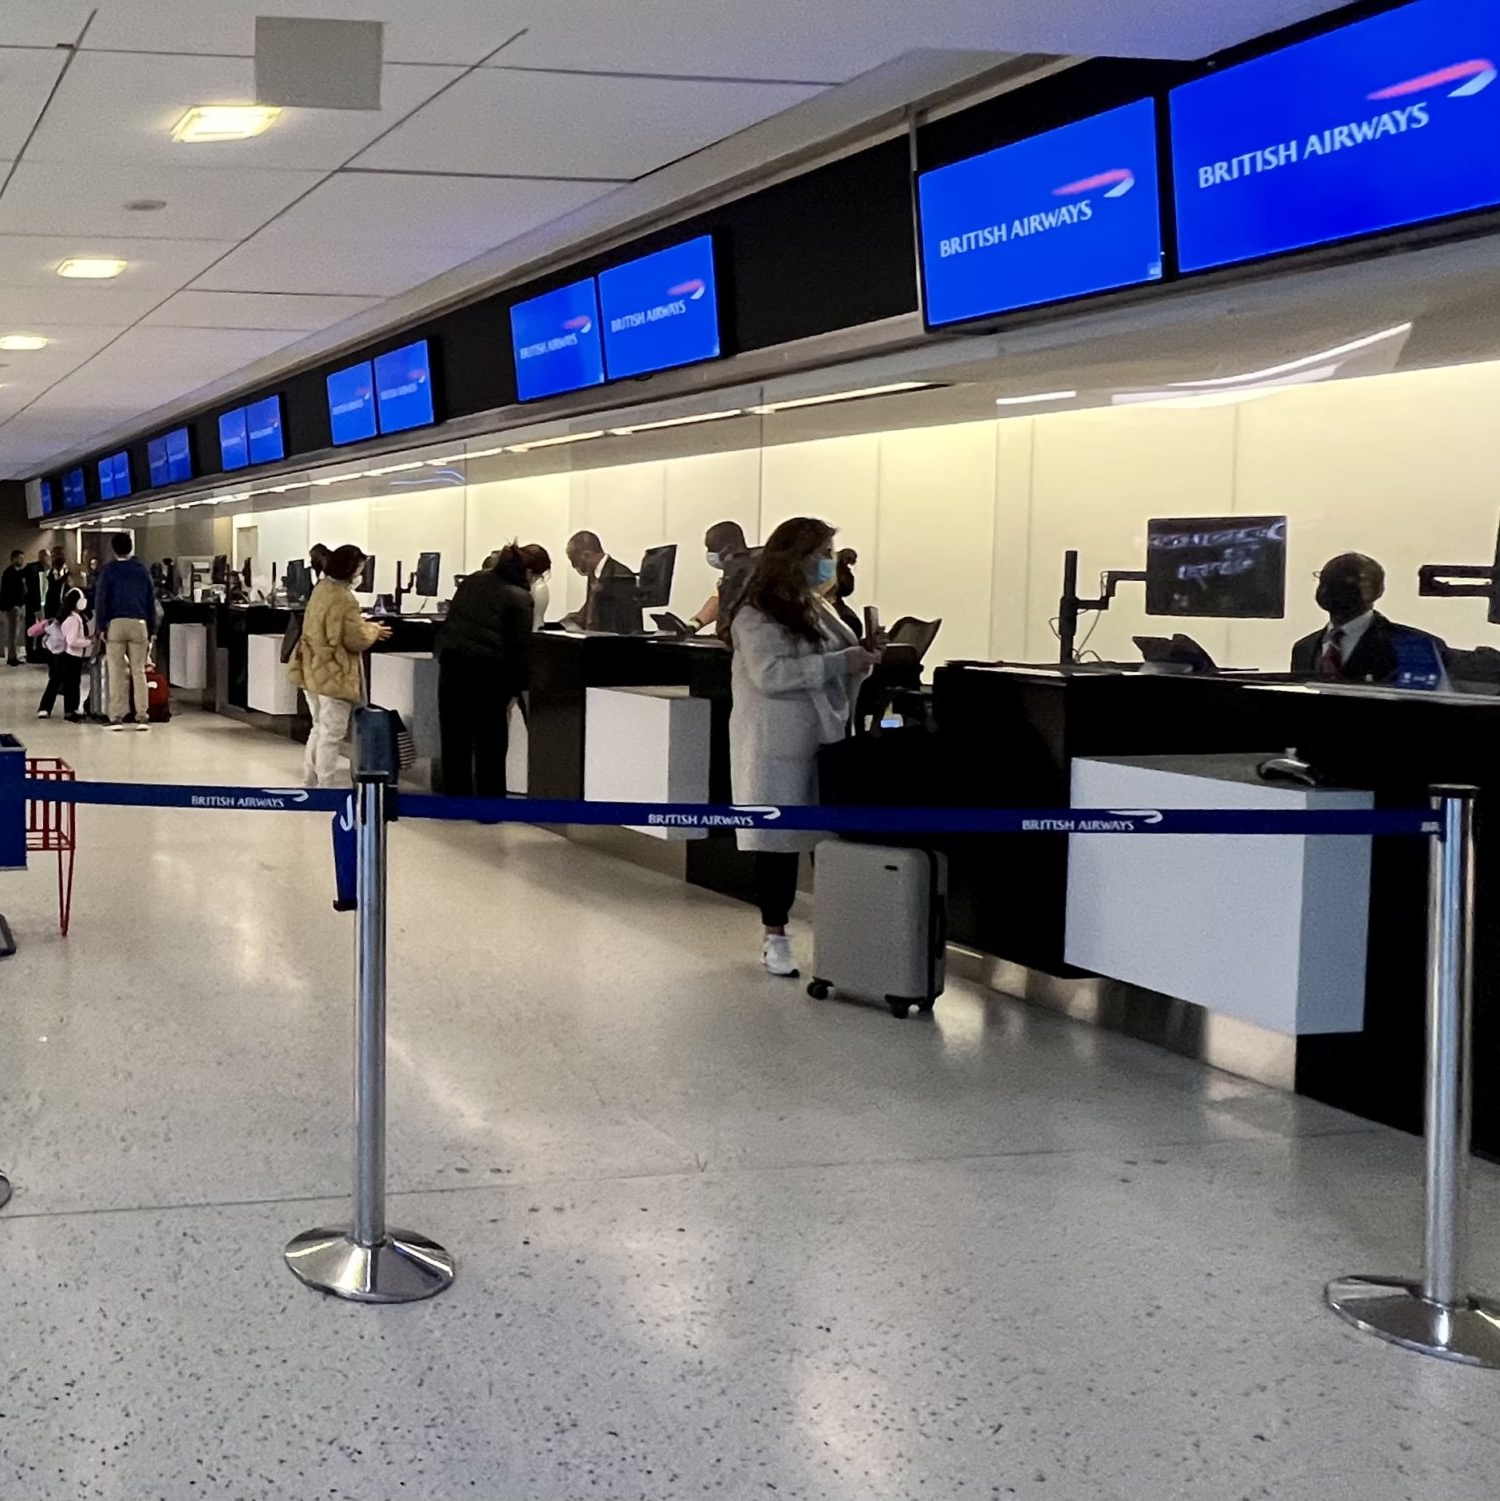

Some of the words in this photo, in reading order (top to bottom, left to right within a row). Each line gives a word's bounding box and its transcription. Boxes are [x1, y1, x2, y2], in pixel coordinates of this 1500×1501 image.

[1198, 141, 1298, 190] BRITISH
[1303, 102, 1431, 160] AIRWAYS
[939, 222, 1008, 258] BRITISH
[1010, 199, 1093, 238] AIRWAYS
[610, 311, 645, 333] BRITISH
[646, 300, 686, 322] AIRWAYS
[191, 795, 235, 807] BRITISH
[237, 797, 285, 808] AIRWAYS
[648, 813, 698, 825] BRITISH
[700, 815, 754, 827] AIRWAYS
[1021, 819, 1075, 831] BRITISH
[1077, 820, 1135, 831] AIRWAYS
